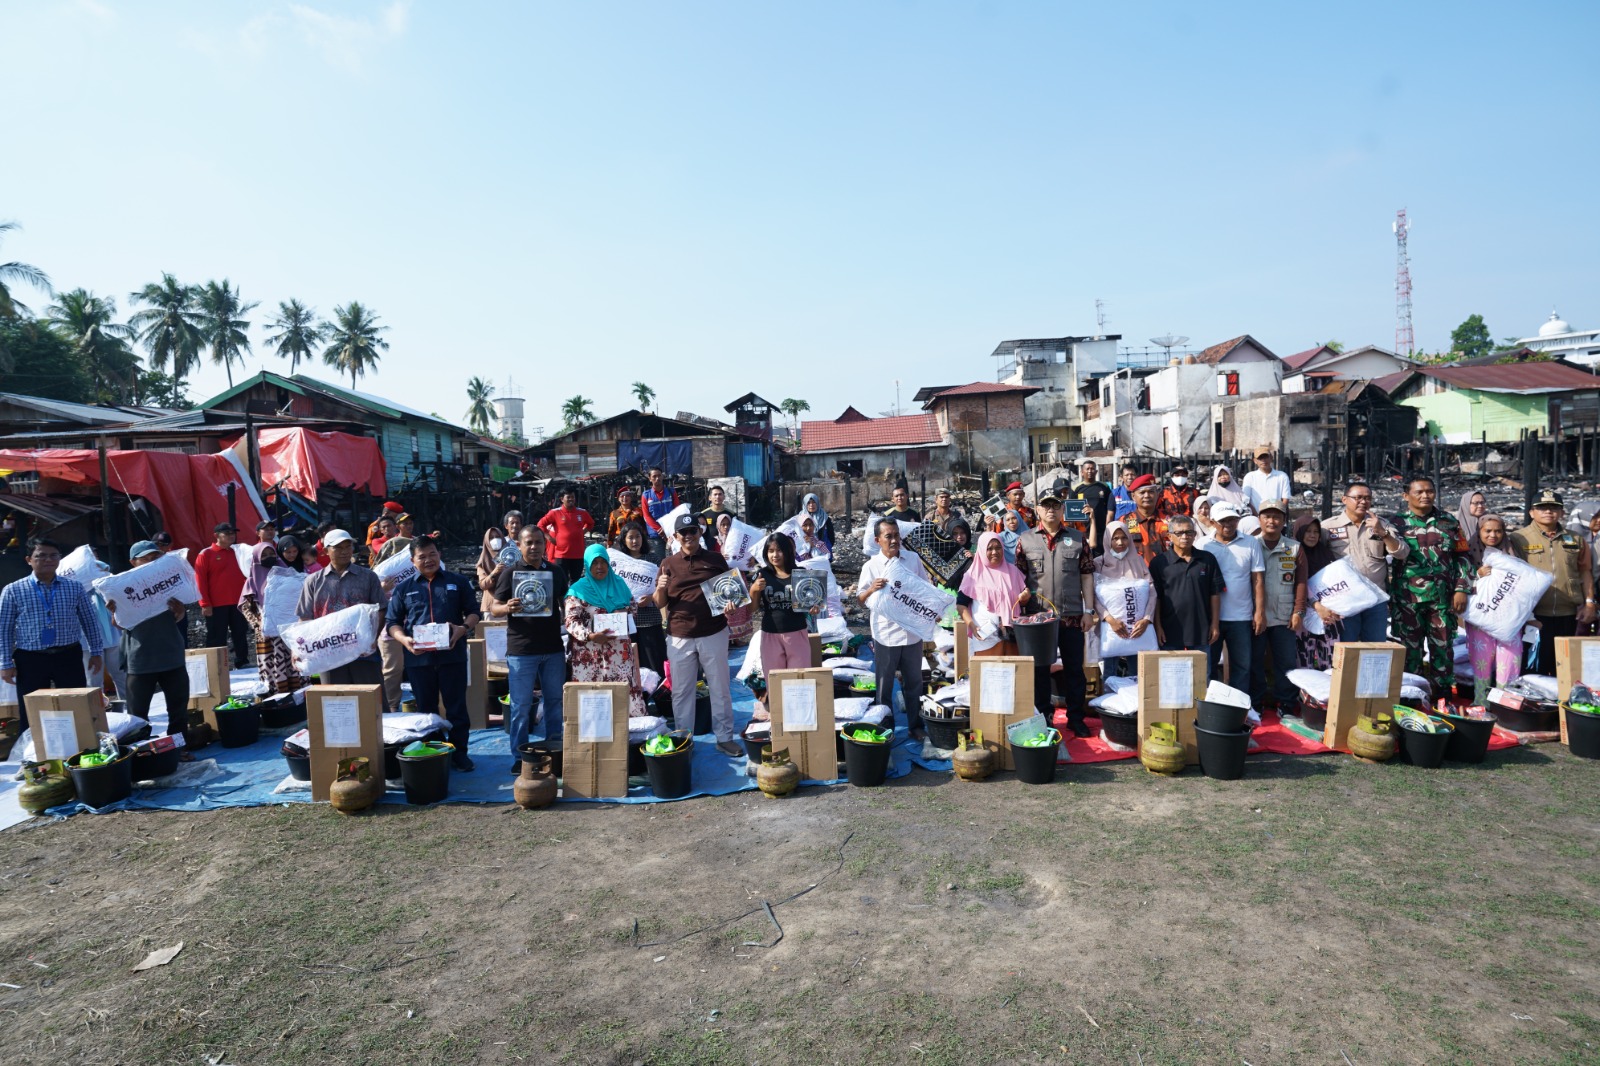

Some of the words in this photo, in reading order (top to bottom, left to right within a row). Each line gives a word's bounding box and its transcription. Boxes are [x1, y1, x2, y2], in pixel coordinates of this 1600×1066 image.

[136, 573, 182, 601] LAURENZA
[618, 570, 653, 584] AURENZA
[1316, 580, 1349, 601] RENZA
[893, 590, 938, 619] LAURENZA
[305, 632, 358, 654] LAURENZA
